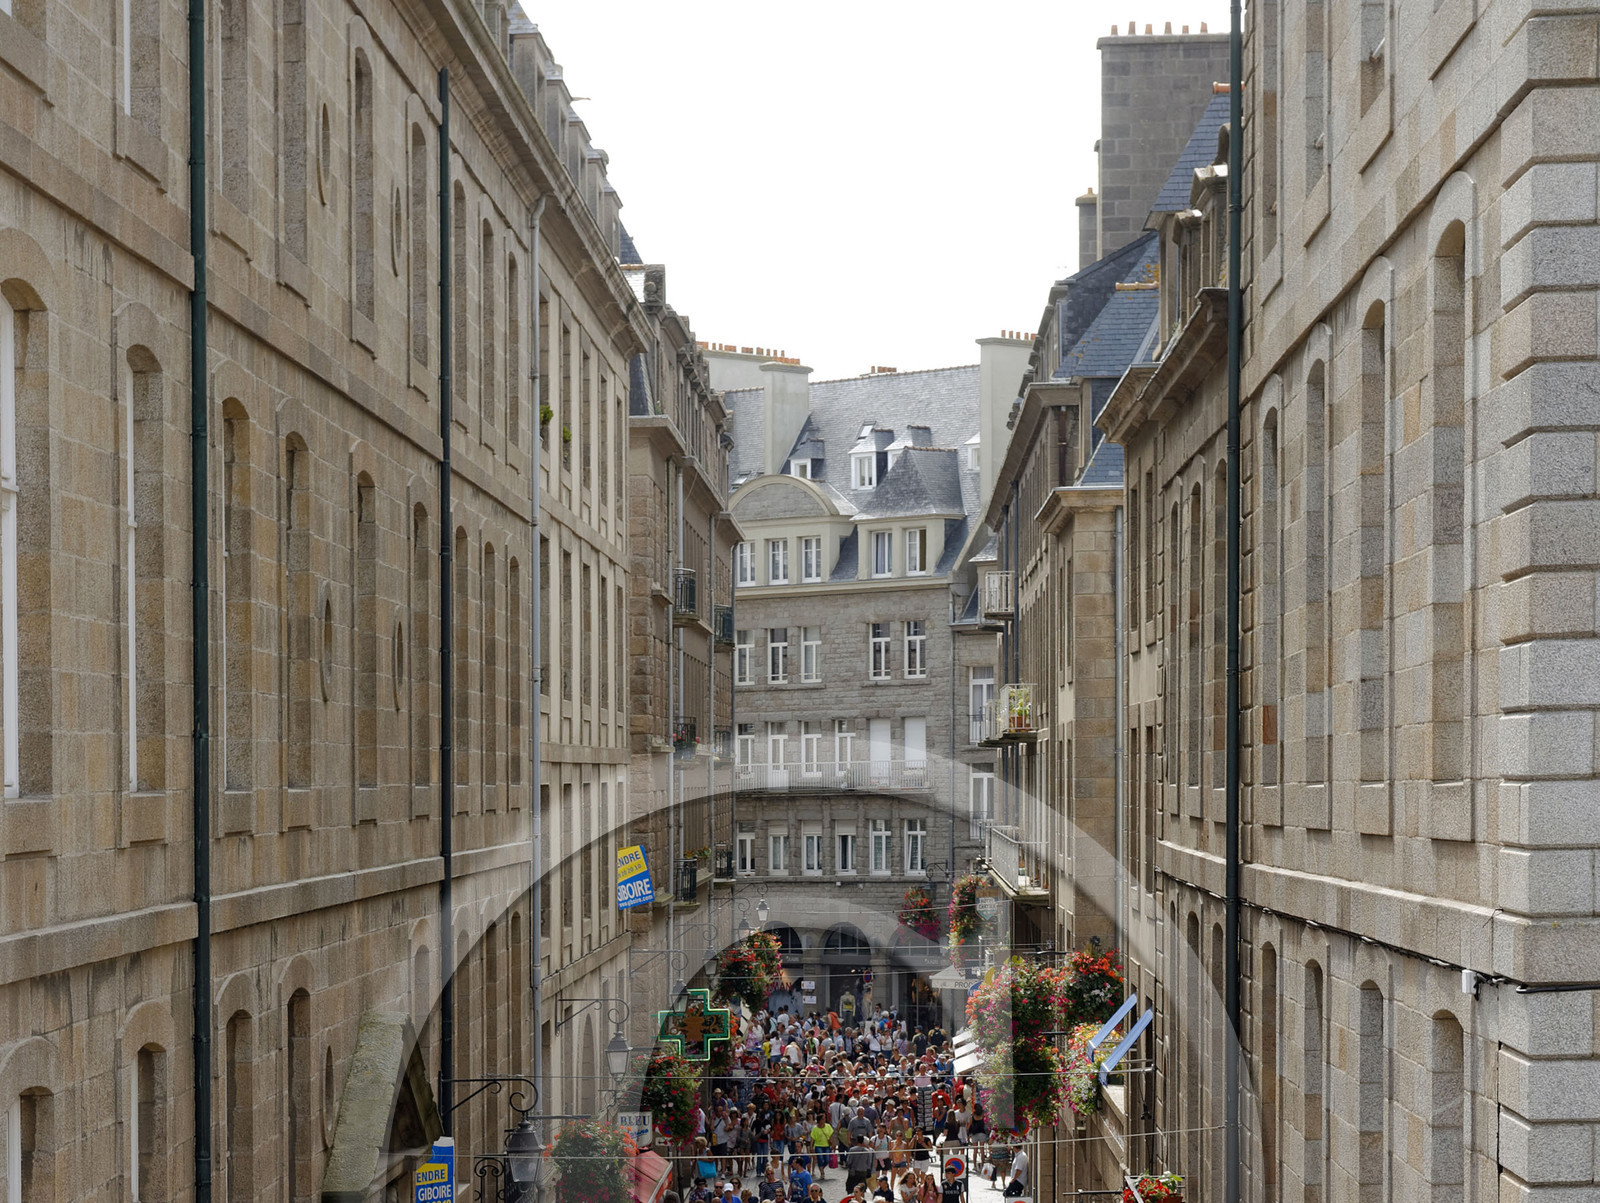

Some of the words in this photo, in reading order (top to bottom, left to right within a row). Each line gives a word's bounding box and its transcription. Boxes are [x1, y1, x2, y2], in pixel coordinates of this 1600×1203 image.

[620, 1115, 650, 1126] BLEU
[416, 1169, 446, 1183] ENDRE
[418, 1184, 452, 1201] GIBOIRE
